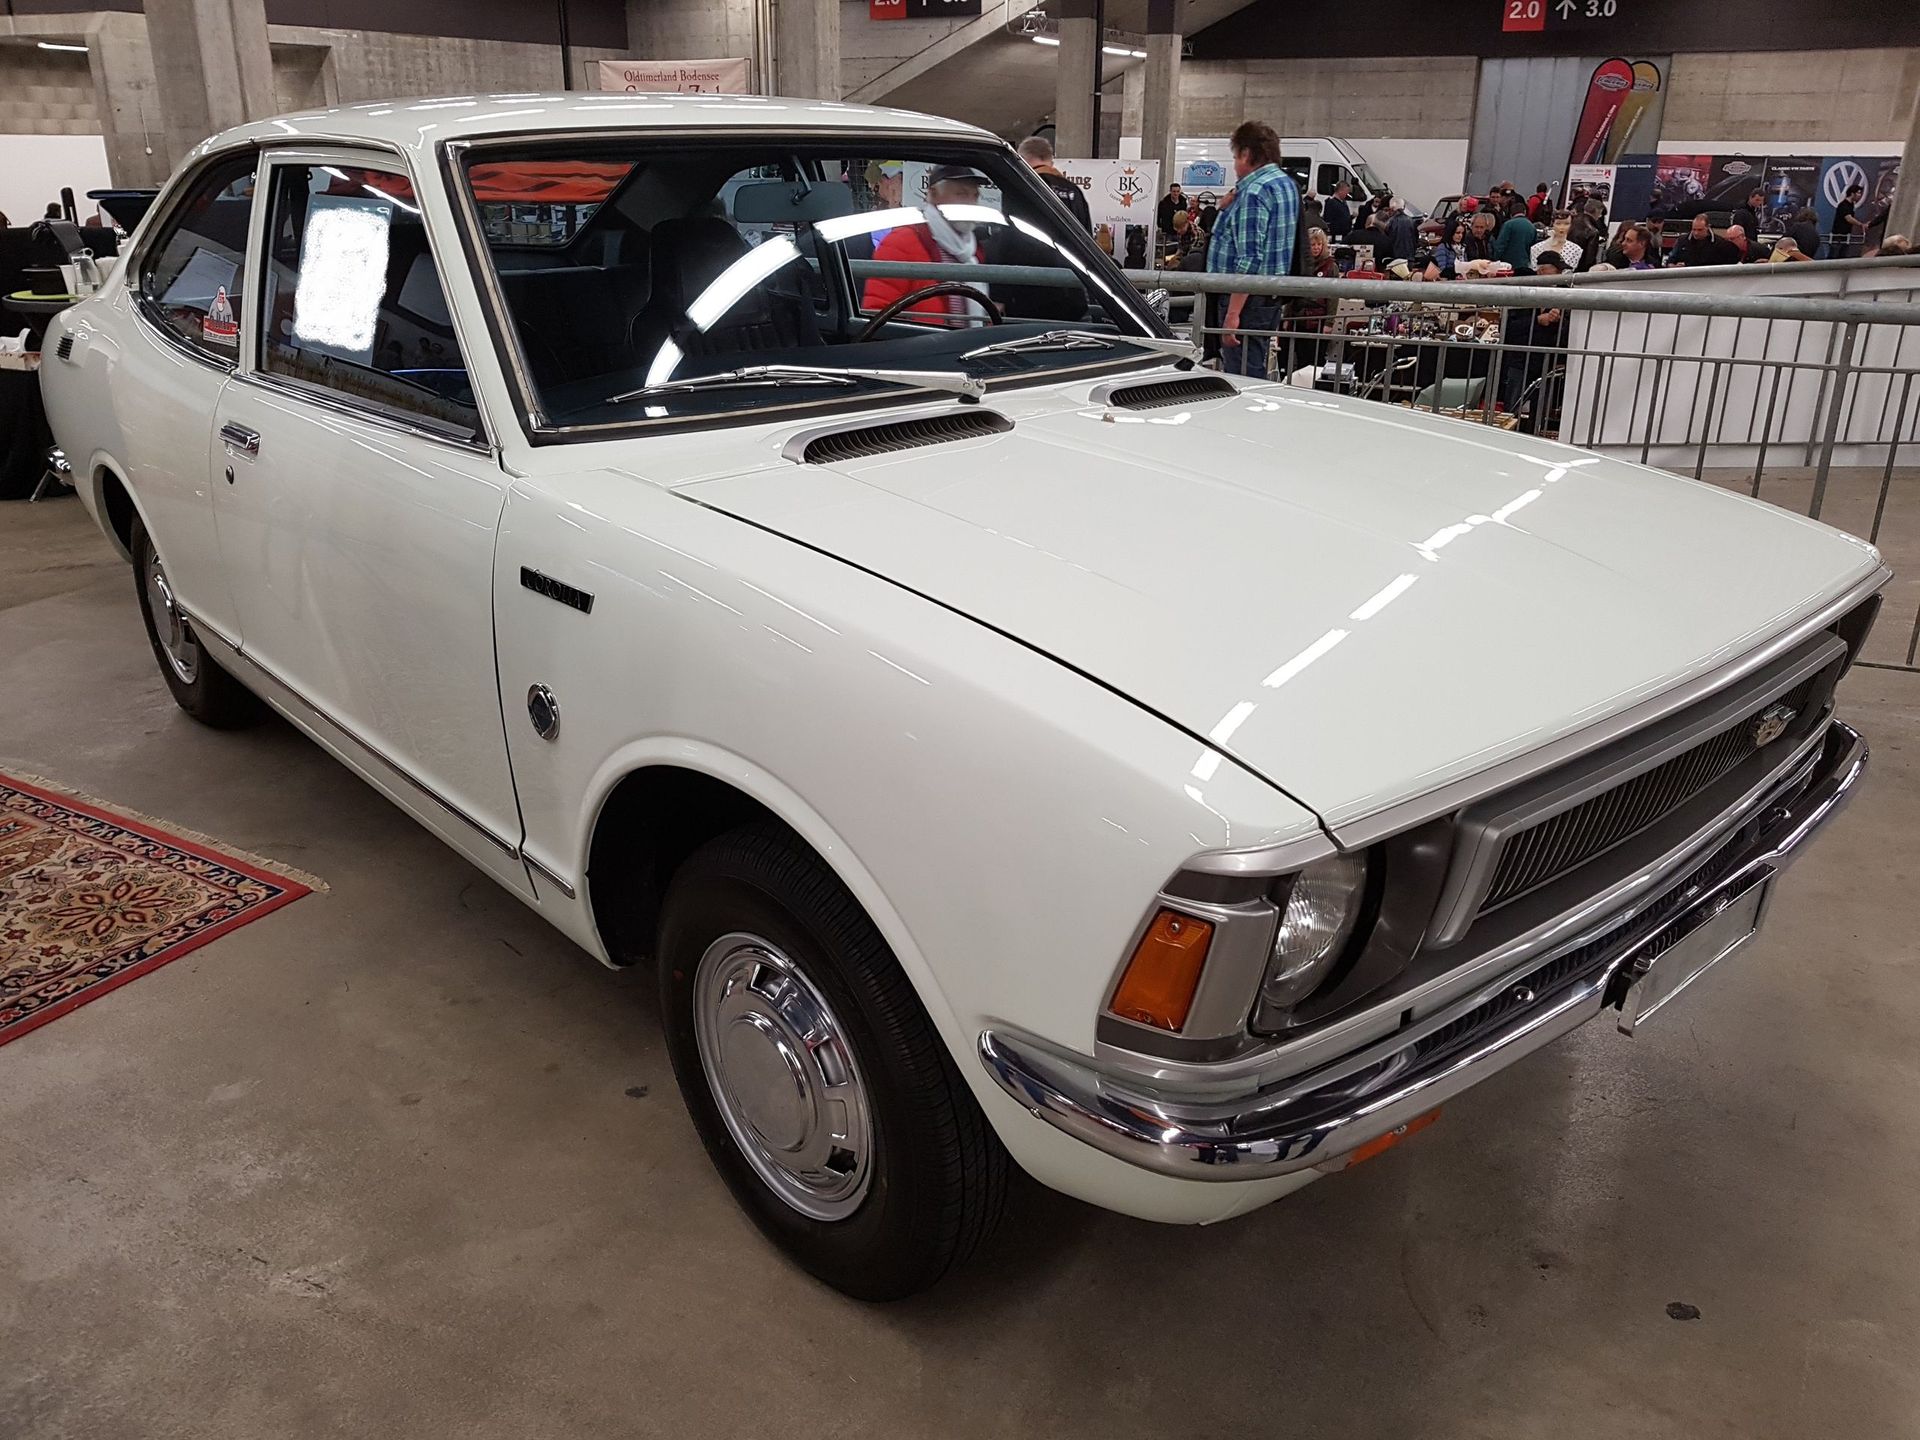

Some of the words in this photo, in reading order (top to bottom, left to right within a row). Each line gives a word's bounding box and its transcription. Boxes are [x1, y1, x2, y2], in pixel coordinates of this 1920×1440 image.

[1509, 1, 1540, 18] 2.0
[1585, 0, 1617, 17] 3.0
[624, 70, 677, 82] Oldtimerland
[680, 69, 720, 81] Bodensee
[1119, 176, 1143, 193] BK
